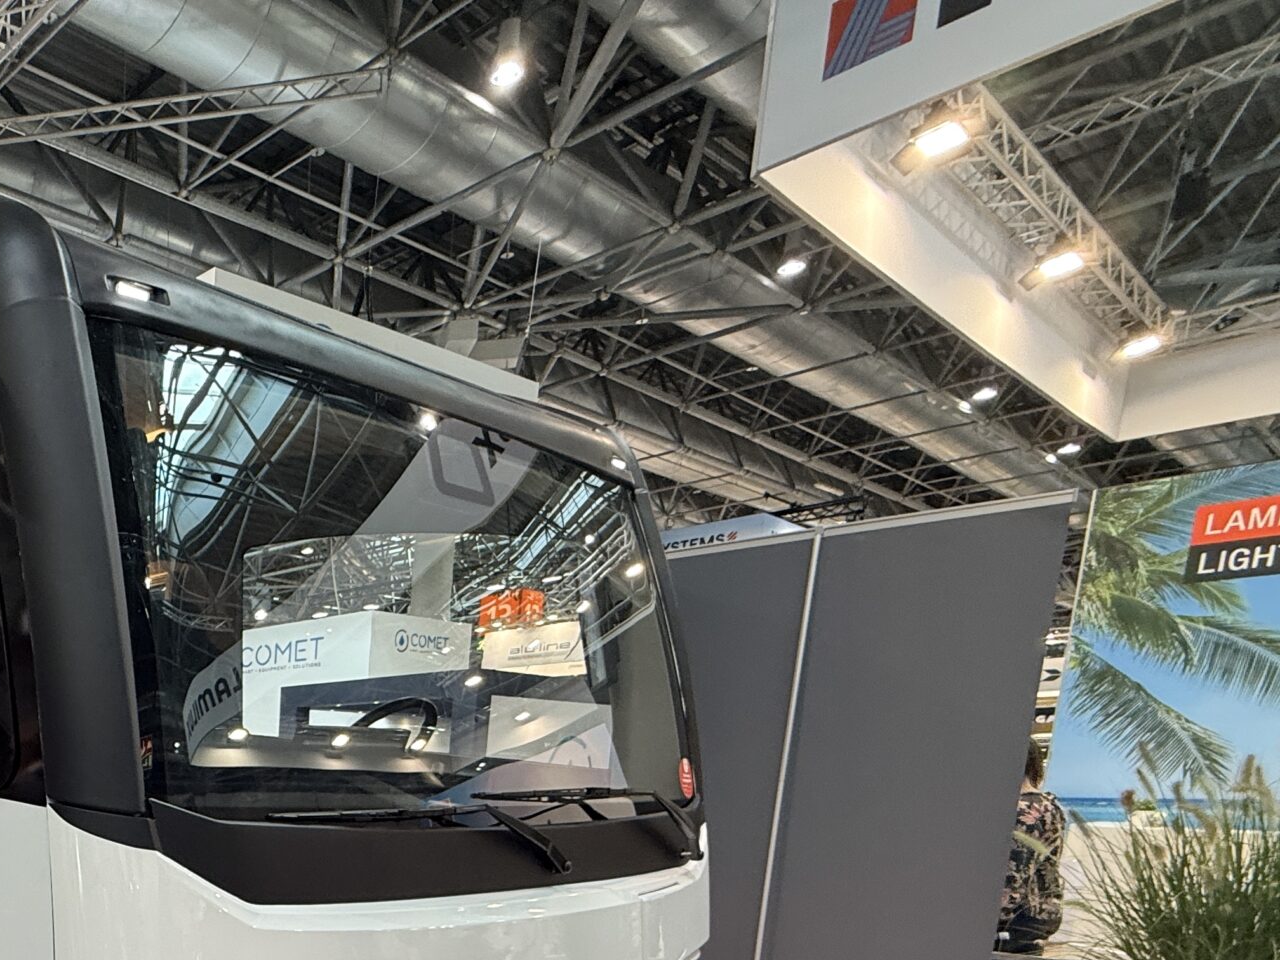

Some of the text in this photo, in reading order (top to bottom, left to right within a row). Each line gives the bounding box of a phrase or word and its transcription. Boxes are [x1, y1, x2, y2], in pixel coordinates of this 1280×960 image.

[1204, 504, 1280, 535] LAM
[1197, 544, 1280, 575] LIGH
[241, 636, 325, 668] COMET
[410, 633, 450, 650] COMET
